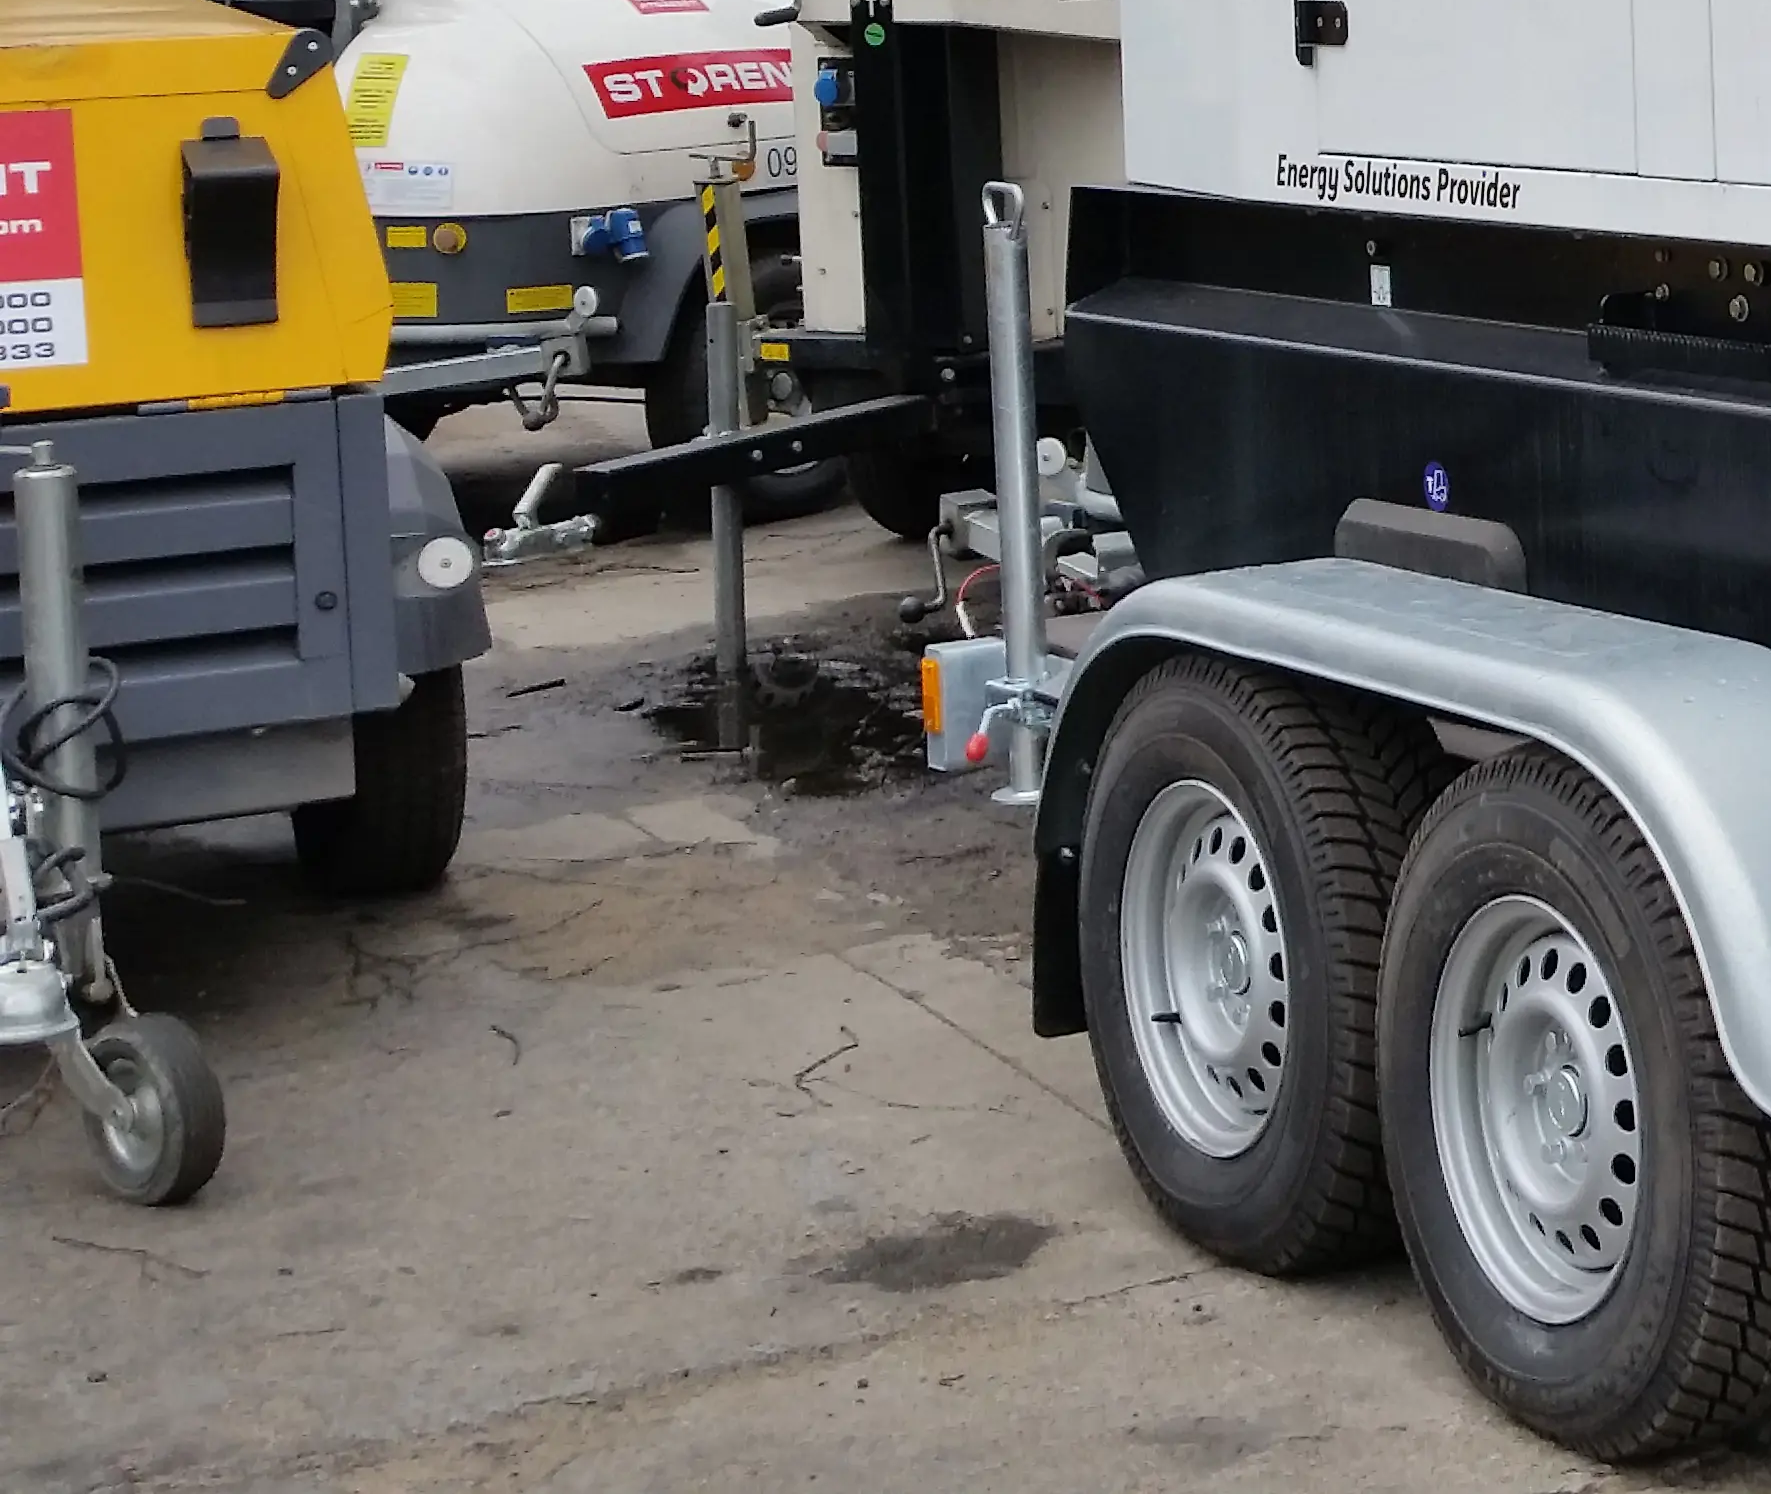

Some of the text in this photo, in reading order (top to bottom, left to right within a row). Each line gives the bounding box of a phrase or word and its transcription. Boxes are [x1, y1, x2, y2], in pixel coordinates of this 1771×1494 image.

[603, 61, 794, 103] STOREN
[1276, 153, 1521, 209] Energy Solutions Provider
